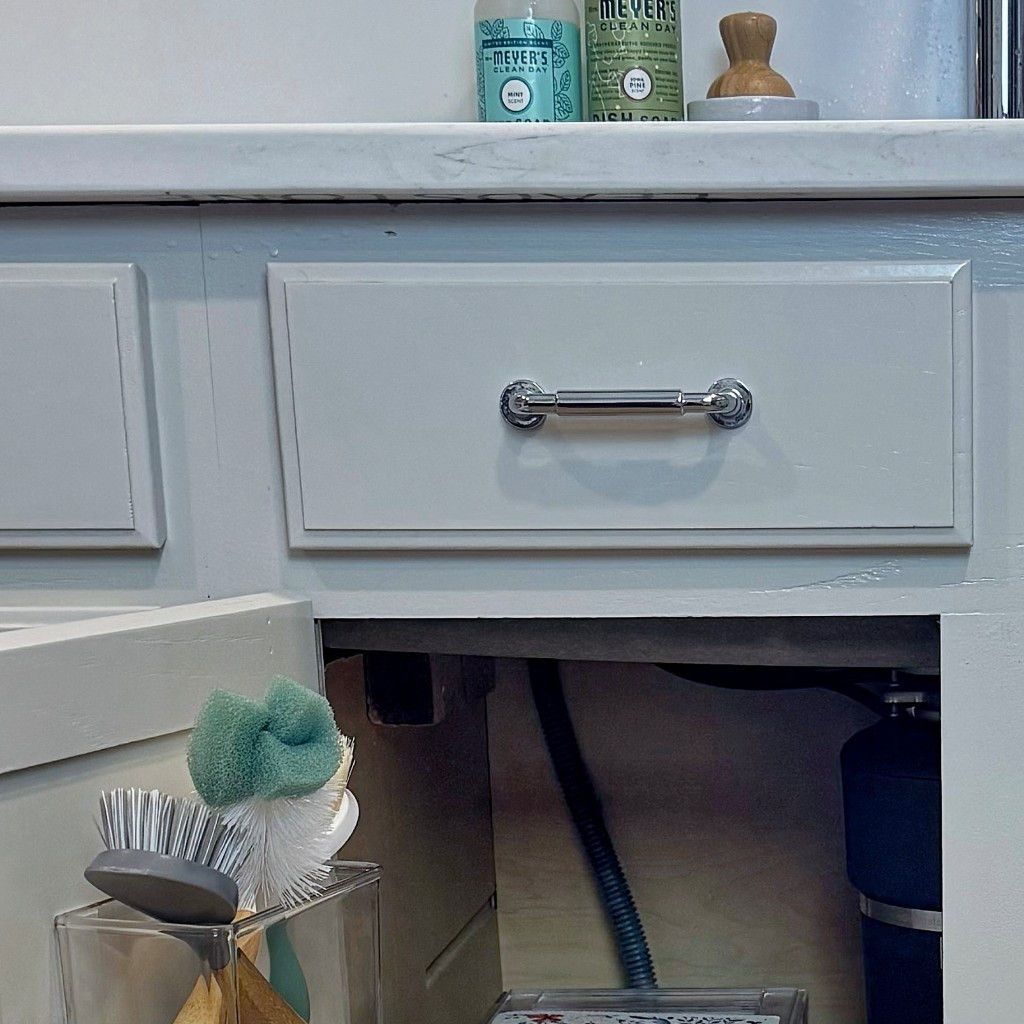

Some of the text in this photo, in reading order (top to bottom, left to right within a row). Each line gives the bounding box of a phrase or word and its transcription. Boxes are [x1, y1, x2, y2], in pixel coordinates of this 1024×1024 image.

[599, 0, 677, 23] MEYER'S
[600, 21, 676, 33] CLEAN DAY
[493, 50, 548, 65] MEYER'S
